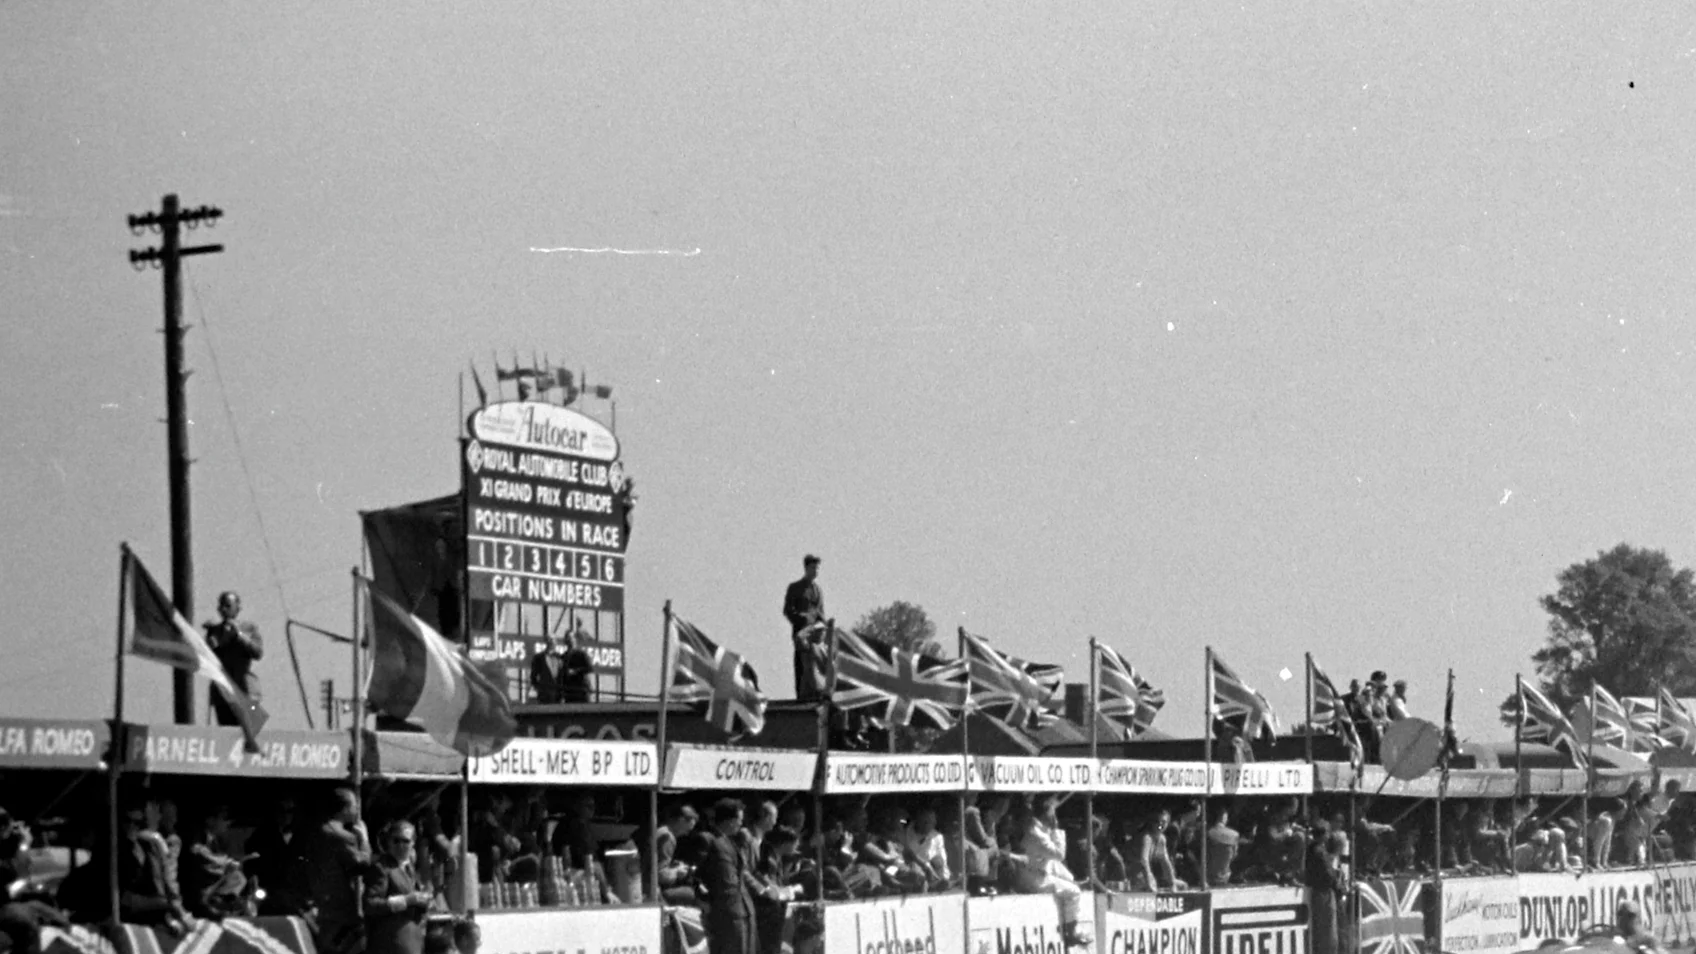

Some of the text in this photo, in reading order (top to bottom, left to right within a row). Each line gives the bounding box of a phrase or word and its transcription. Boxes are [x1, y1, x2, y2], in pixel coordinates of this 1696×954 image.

[516, 405, 588, 451] Autocar
[518, 453, 579, 483] AUTOMOBILE
[581, 462, 608, 487] CLUB
[480, 477, 493, 497] XI
[494, 479, 532, 502] GRAND
[536, 485, 562, 507] PRIX
[474, 508, 620, 548] POSITIONS IN RACE
[503, 545, 514, 570] 2
[531, 547, 541, 572] 3
[555, 551, 566, 576] 4
[580, 554, 591, 578] 5
[604, 557, 615, 582] 6
[491, 575, 601, 607] CAR NUMBERS
[499, 640, 526, 661] LAPS
[583, 646, 623, 668] EADER
[0, 727, 95, 756] LFA ROMEO
[133, 735, 220, 764] PARNELL
[228, 737, 244, 768] 4
[289, 742, 341, 769] ROMEO
[592, 752, 614, 777] BP
[714, 758, 776, 782] CONTROL
[888, 762, 930, 785] PRODUCTS
[980, 763, 1025, 785] VACUUM
[1028, 763, 1043, 785] OIL
[1224, 769, 1269, 788] PIRELLI
[1520, 896, 1588, 939] DUNLOP
